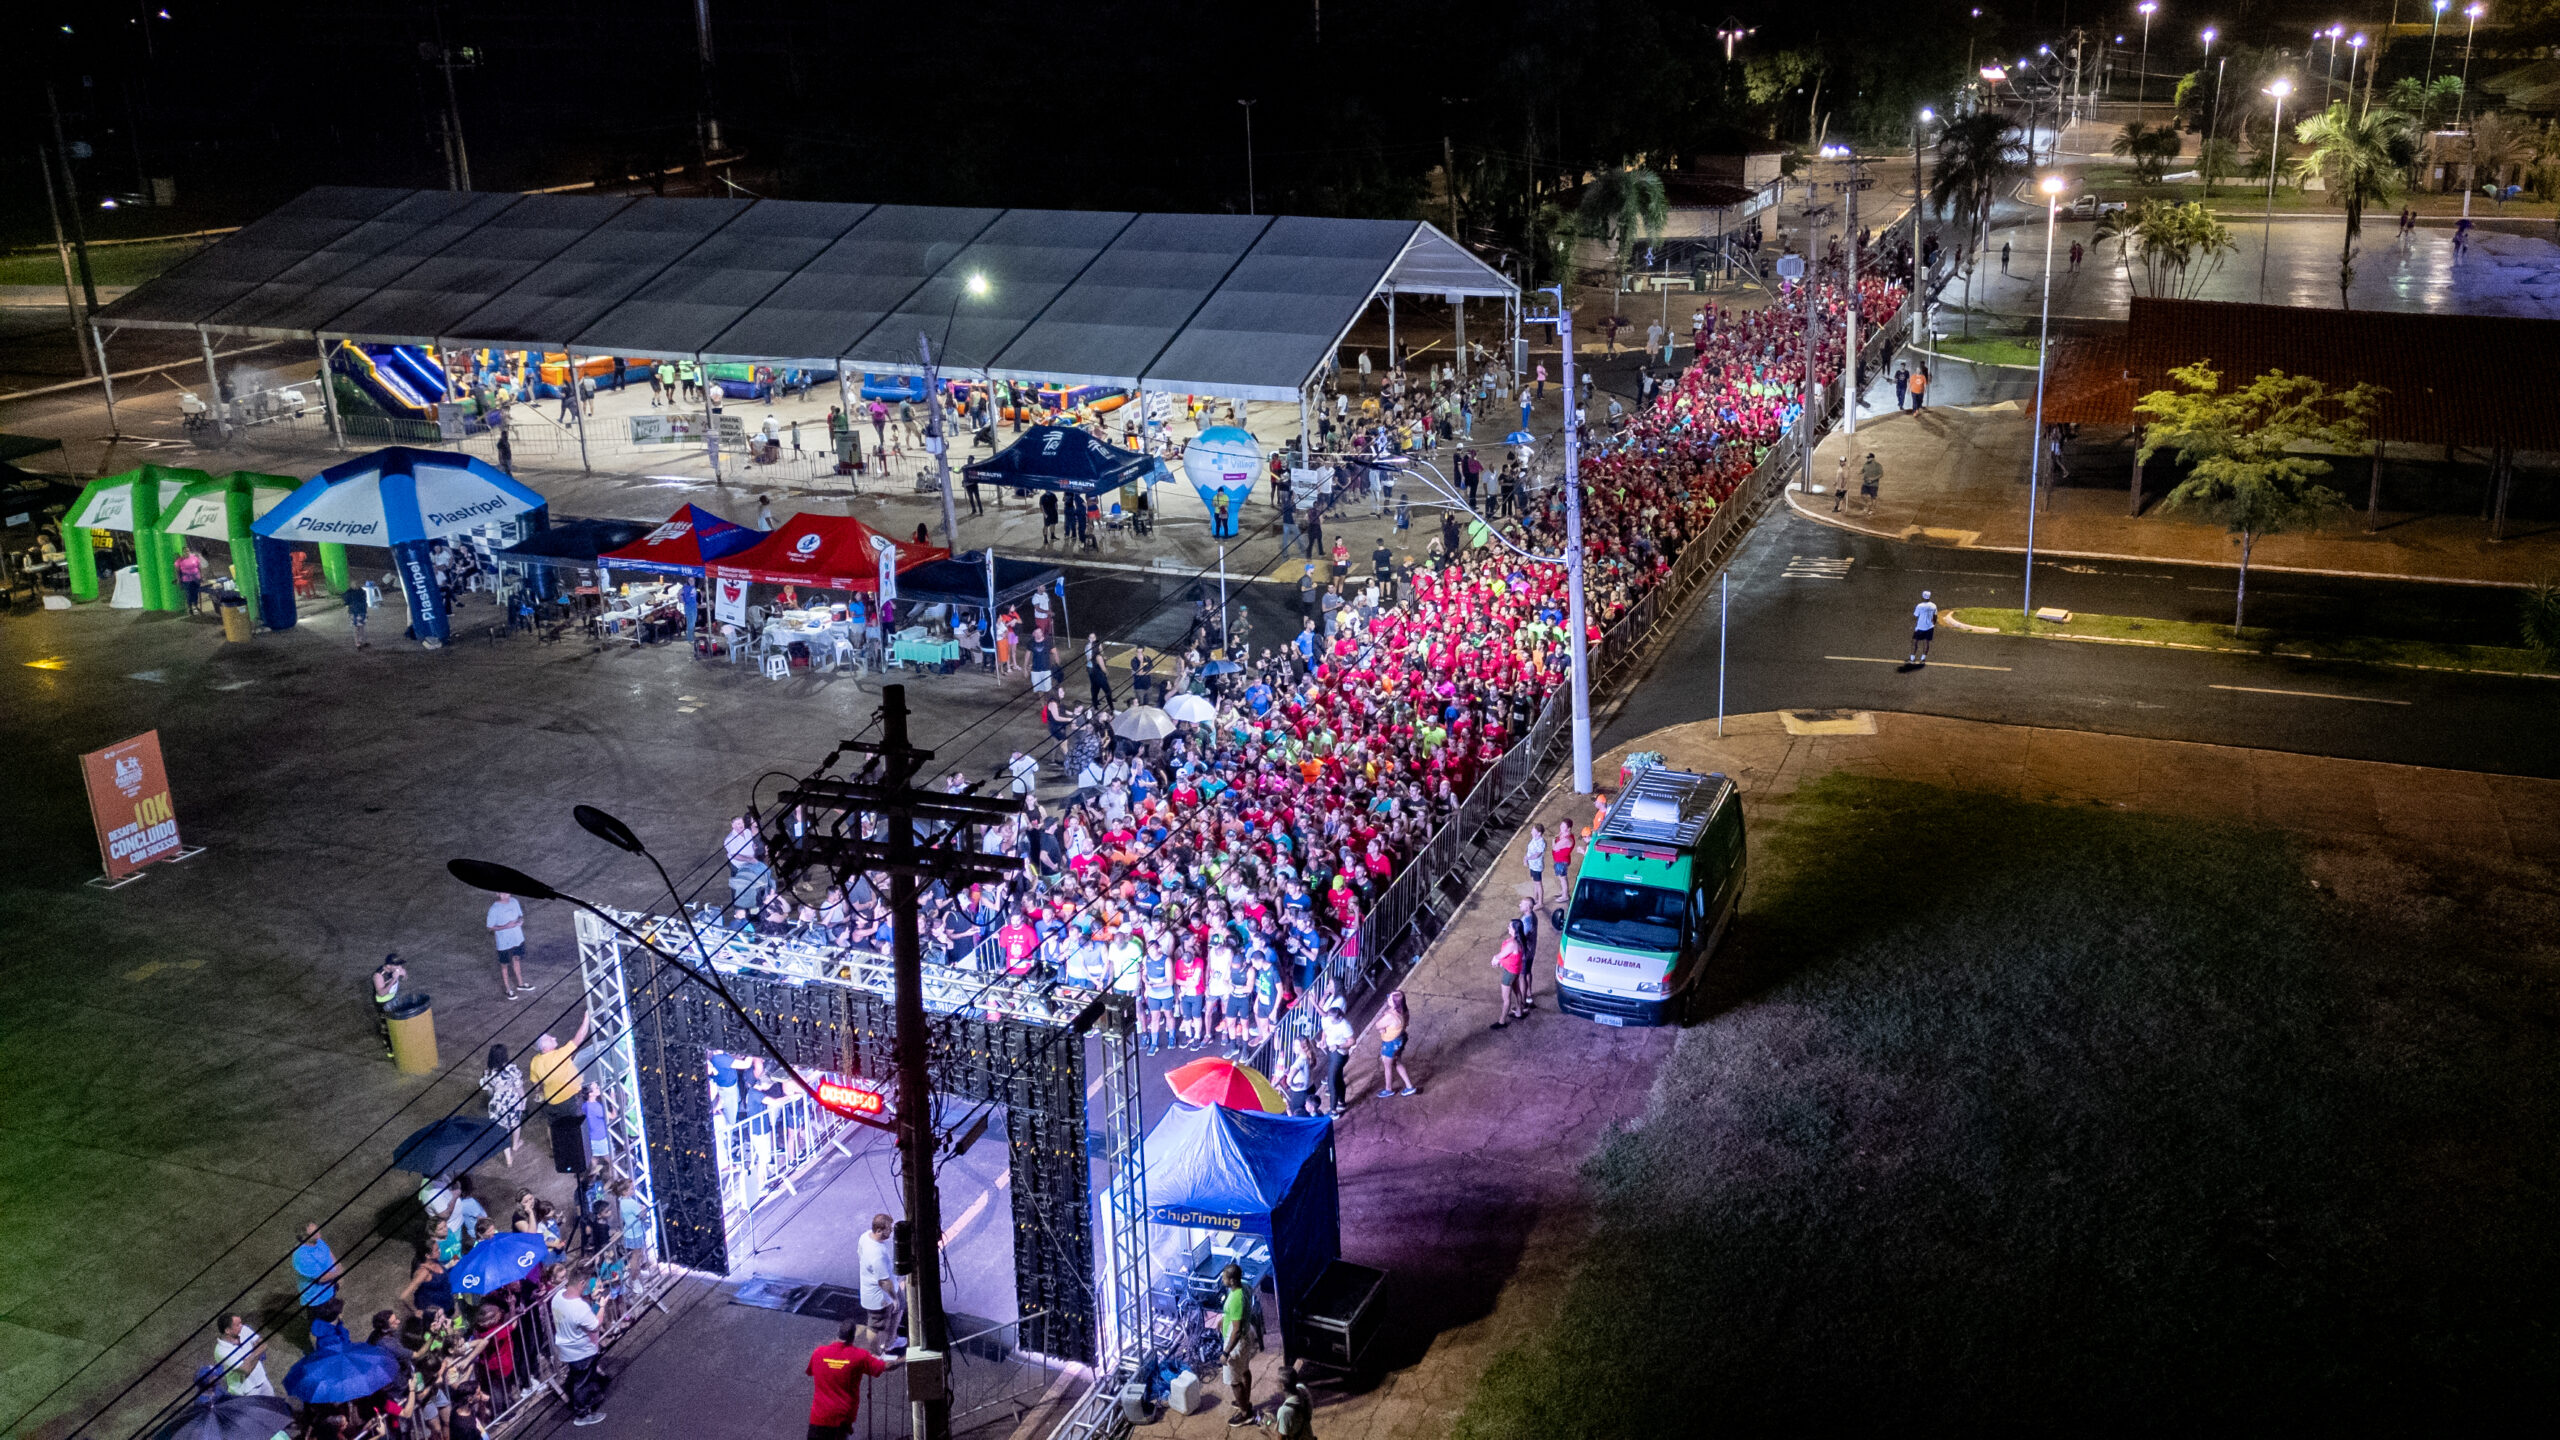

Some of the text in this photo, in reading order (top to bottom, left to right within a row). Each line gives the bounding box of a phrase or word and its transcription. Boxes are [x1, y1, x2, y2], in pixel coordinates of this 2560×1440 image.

[428, 494, 508, 527] Plastripel
[296, 517, 379, 536] Plastripel
[407, 561, 436, 622] Plastripel
[108, 822, 139, 842] DESAFIO
[134, 791, 173, 829] 10K
[129, 835, 180, 864] COM SUCESSO
[1156, 1208, 1242, 1230] ChipTiming
